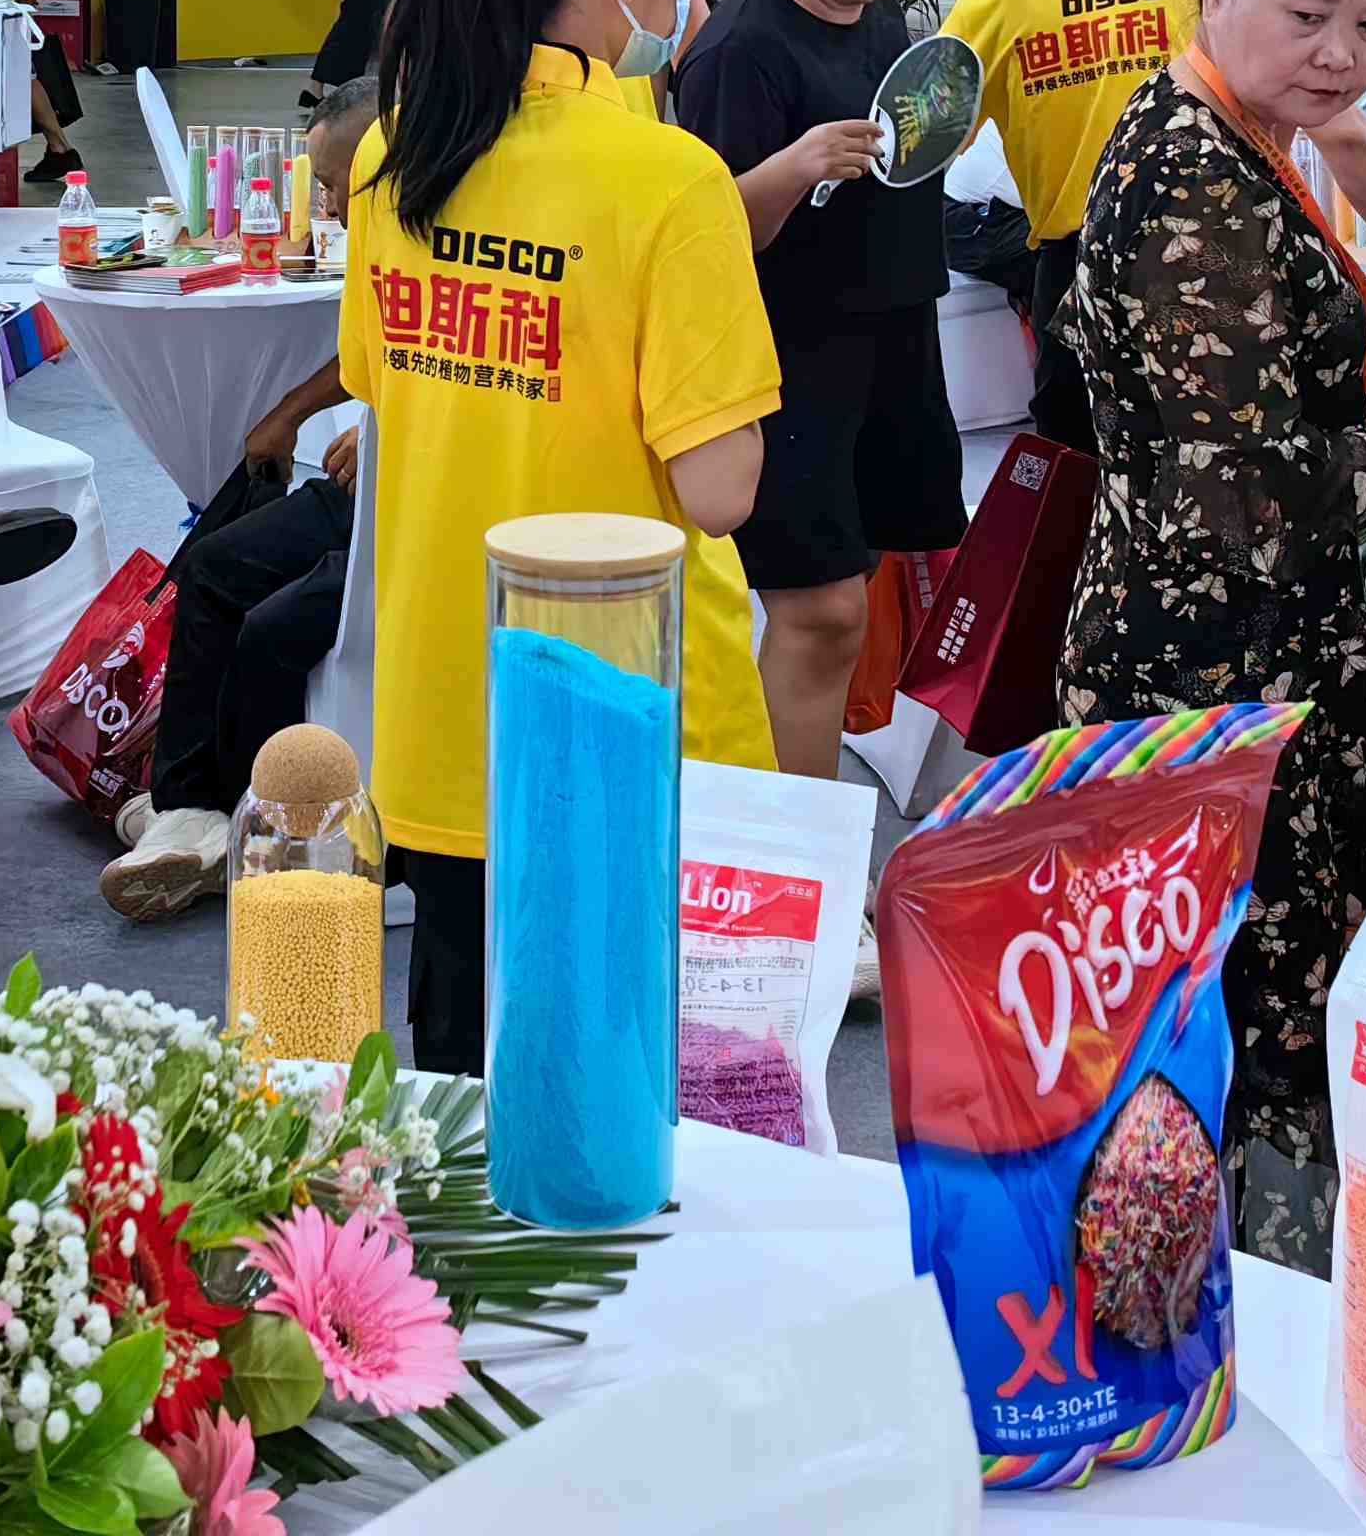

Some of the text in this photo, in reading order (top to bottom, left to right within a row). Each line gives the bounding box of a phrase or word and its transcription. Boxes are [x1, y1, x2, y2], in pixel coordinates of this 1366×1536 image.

[1014, 6, 1170, 81] 迪斯科
[431, 225, 566, 283] DISCO
[371, 263, 563, 371] 迪斯科
[681, 871, 752, 914] Lion
[992, 1385, 1118, 1425] 13-4-30+TE
